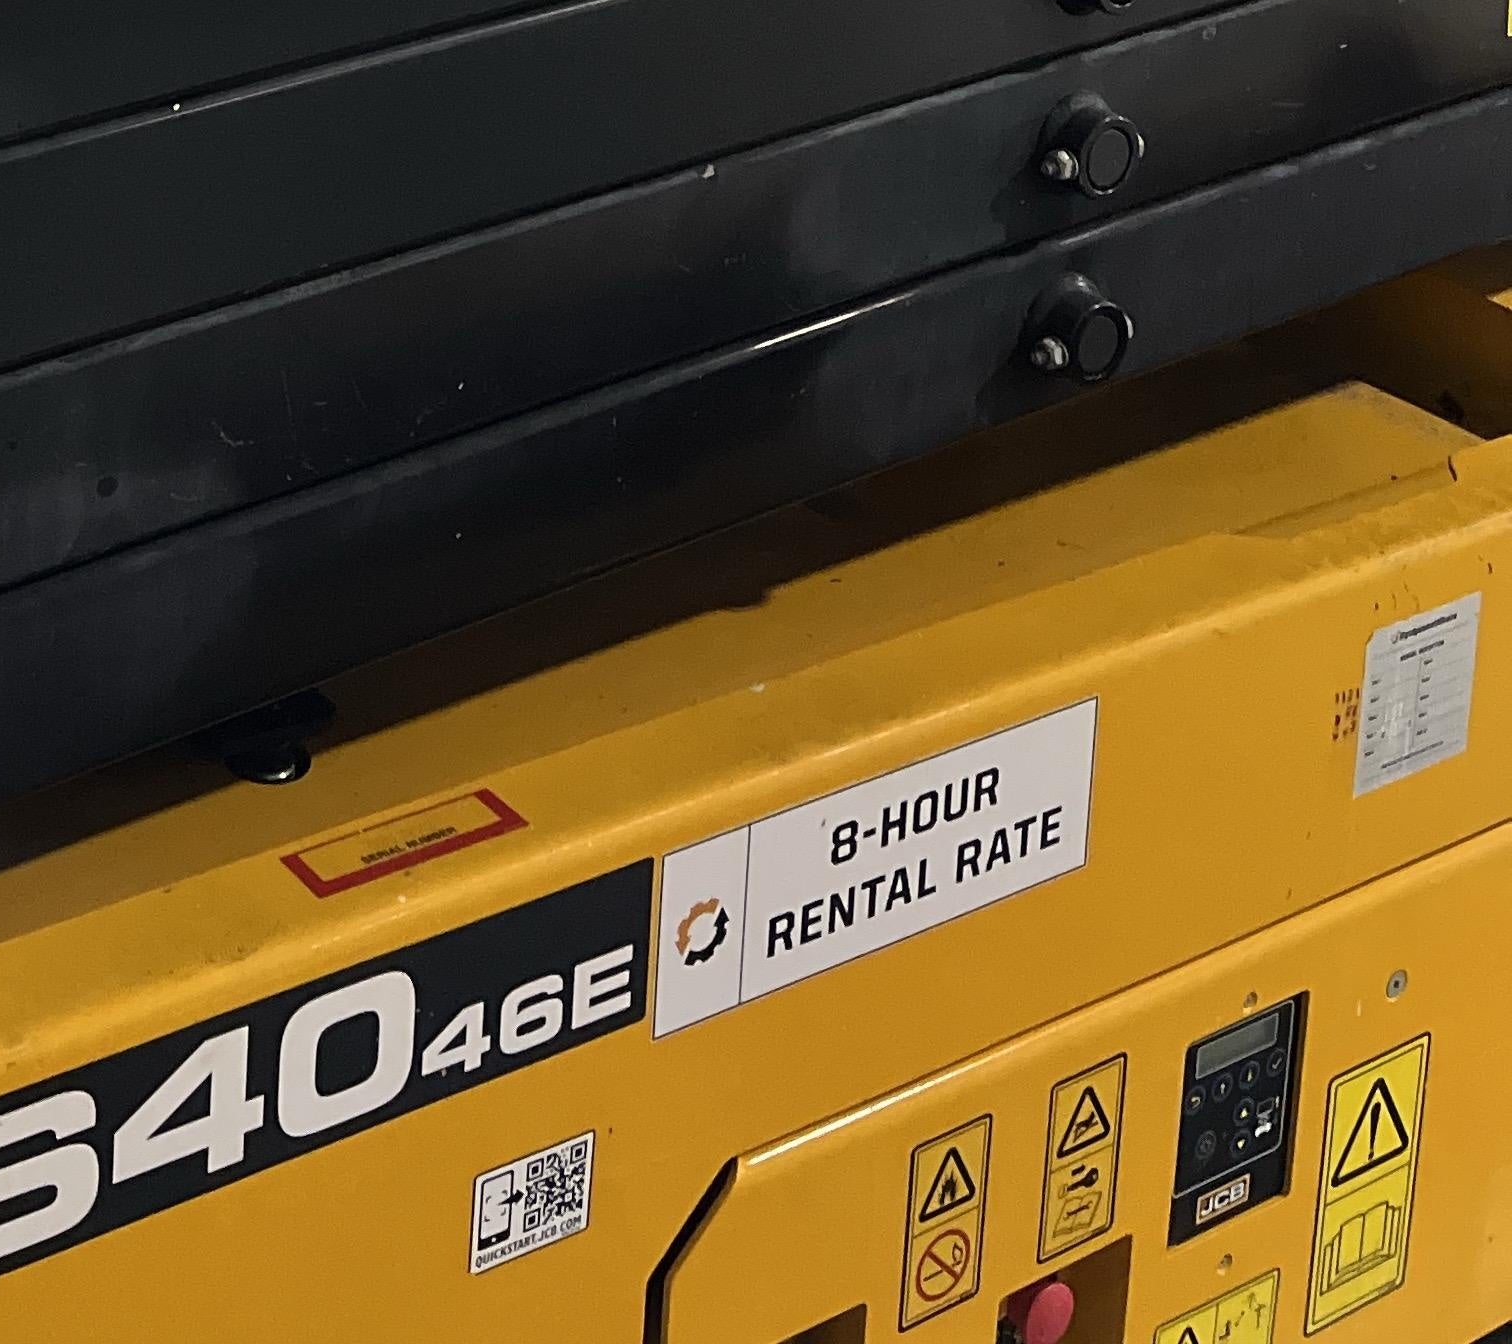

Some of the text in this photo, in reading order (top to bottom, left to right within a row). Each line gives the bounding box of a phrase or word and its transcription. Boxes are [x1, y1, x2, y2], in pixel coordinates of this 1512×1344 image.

[830, 766, 1000, 866] 8-HOUR
[766, 805, 1063, 959] RENTAL RATE
[1200, 1181, 1245, 1217] JCB
